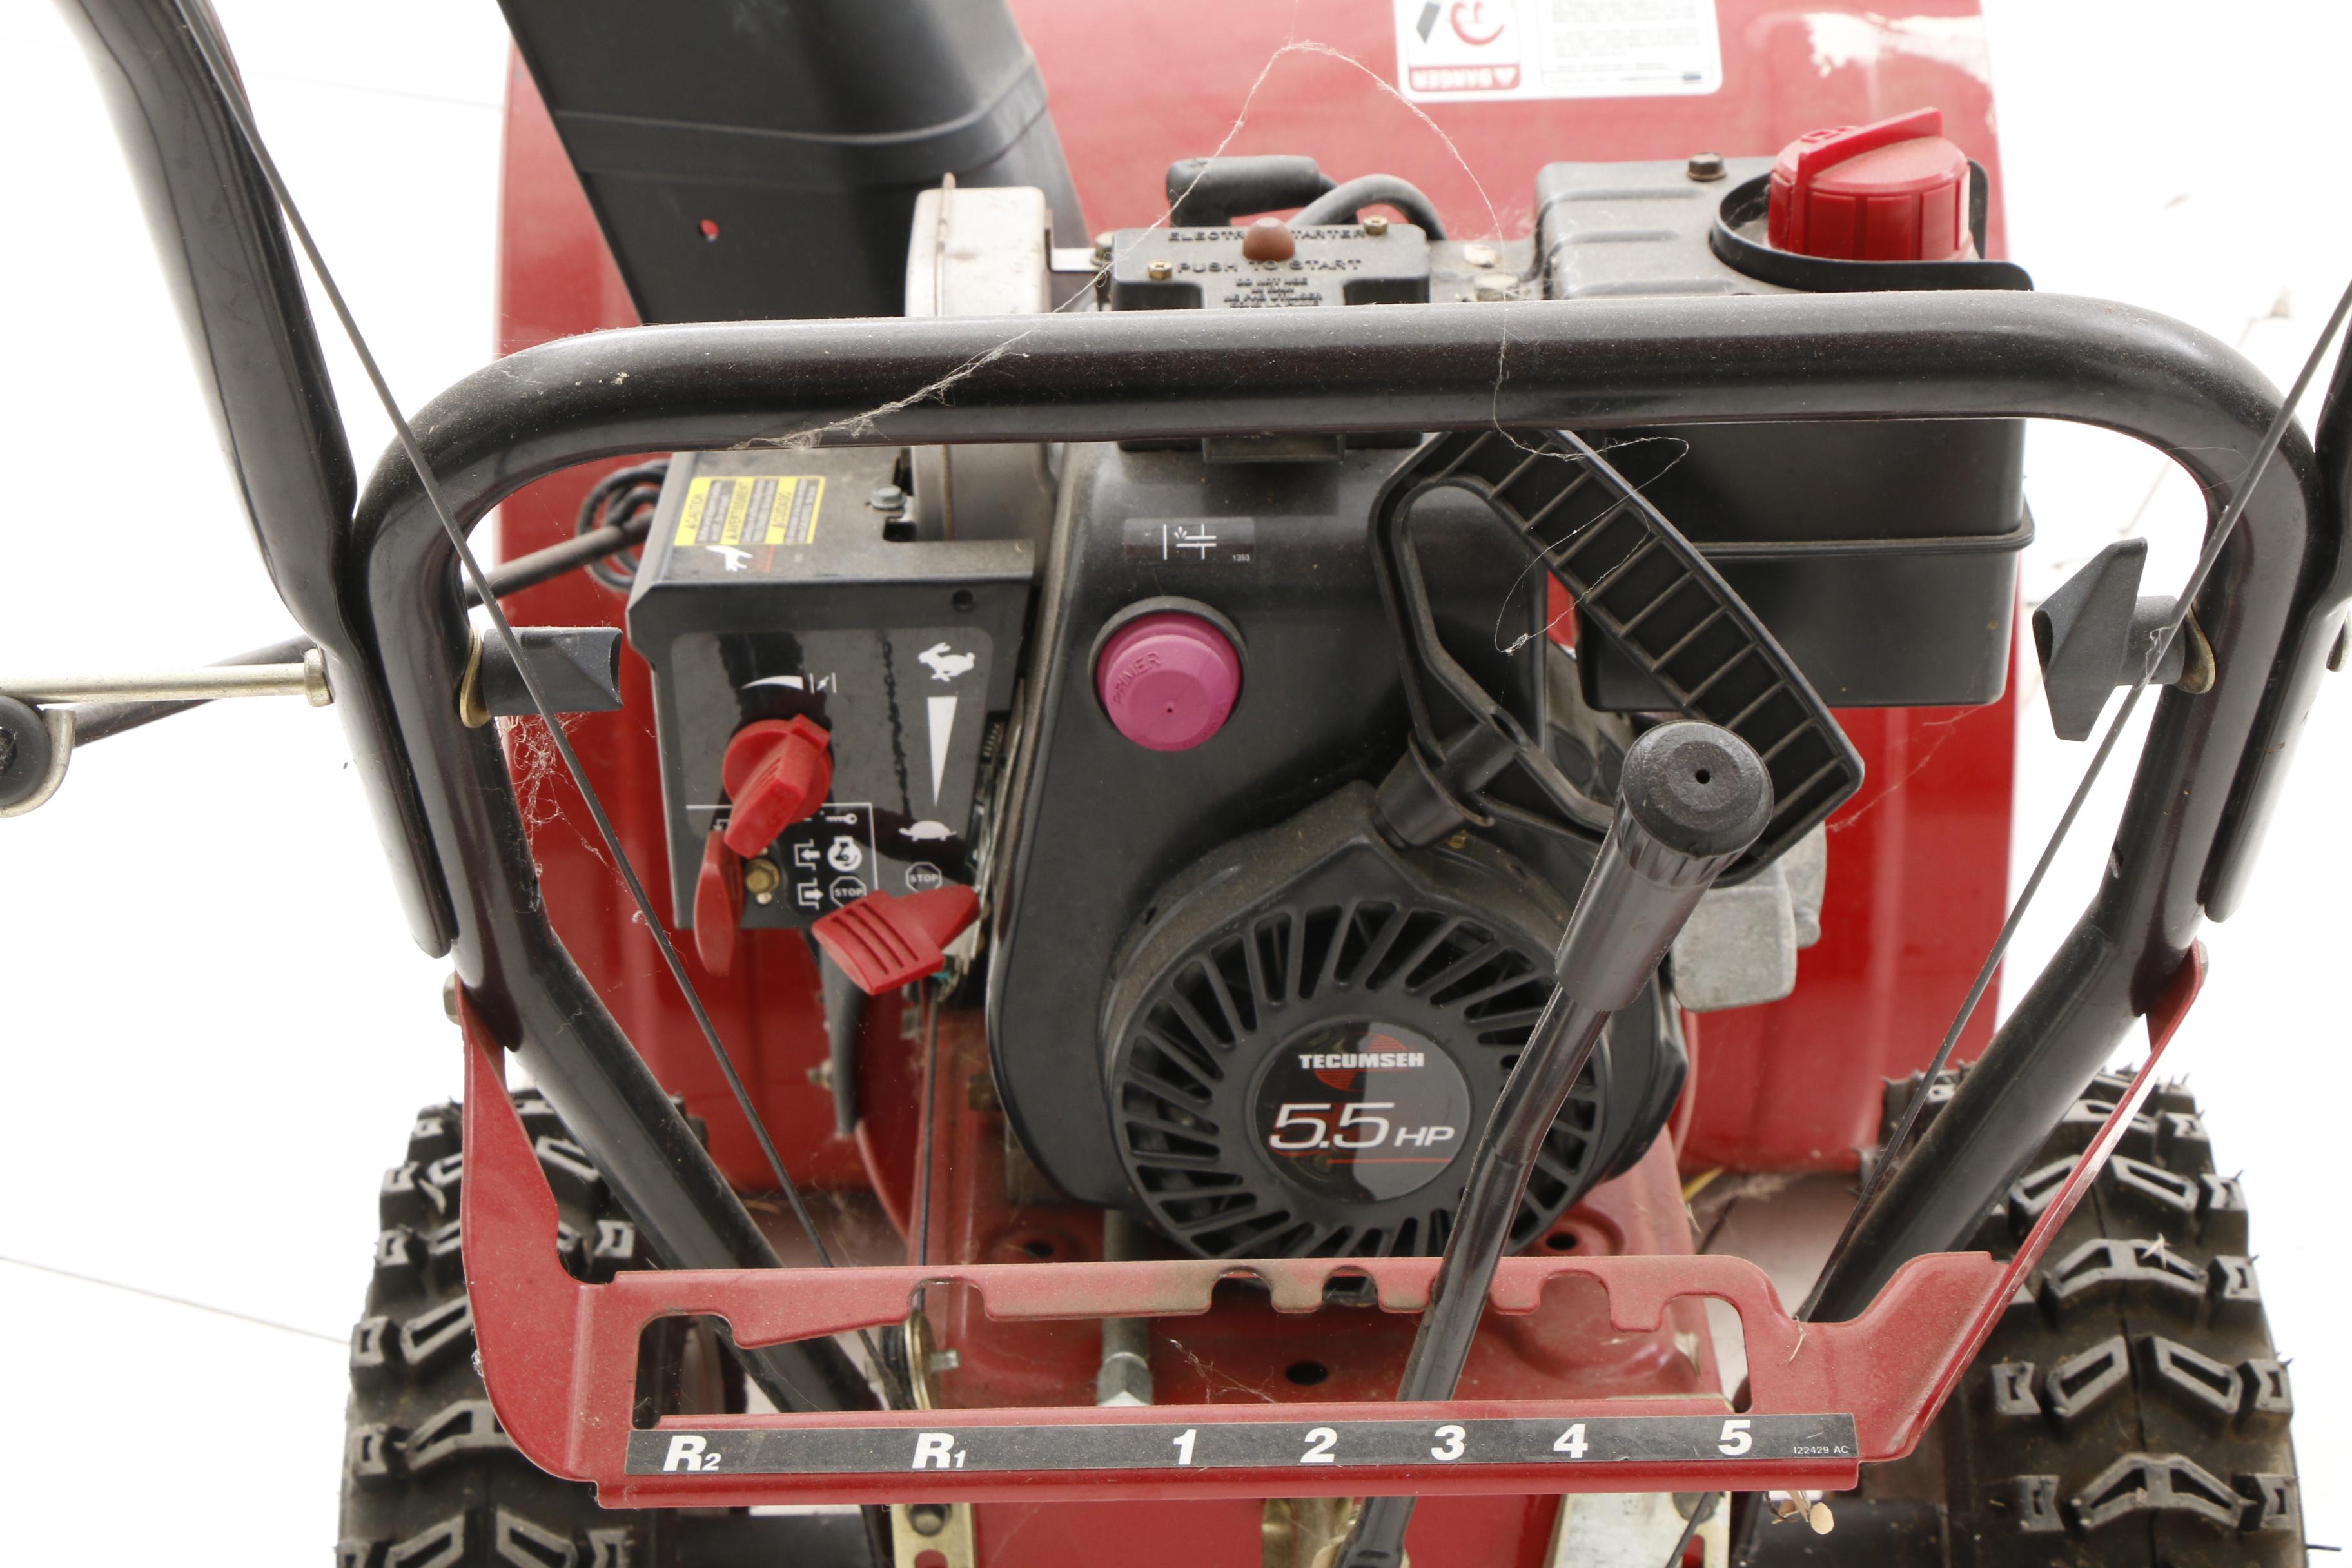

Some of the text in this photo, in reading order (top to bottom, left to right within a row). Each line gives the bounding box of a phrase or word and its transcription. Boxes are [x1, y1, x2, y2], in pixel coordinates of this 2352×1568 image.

[1412, 67, 1492, 88] DANGER
[1168, 230, 1366, 241] ELECTR TARTER
[1178, 259, 1362, 273] PUSH TO START
[1113, 651, 1161, 707] PRIMER
[910, 874, 939, 883] STOP
[835, 887, 863, 897] STOP
[1299, 1052, 1425, 1069] TECUMSEH
[1269, 1102, 1455, 1150] 5.5 HP
[663, 1419, 1752, 1471] R2 R1 1 2 3 4 5
[1793, 1446, 1849, 1455] 122429 AC
